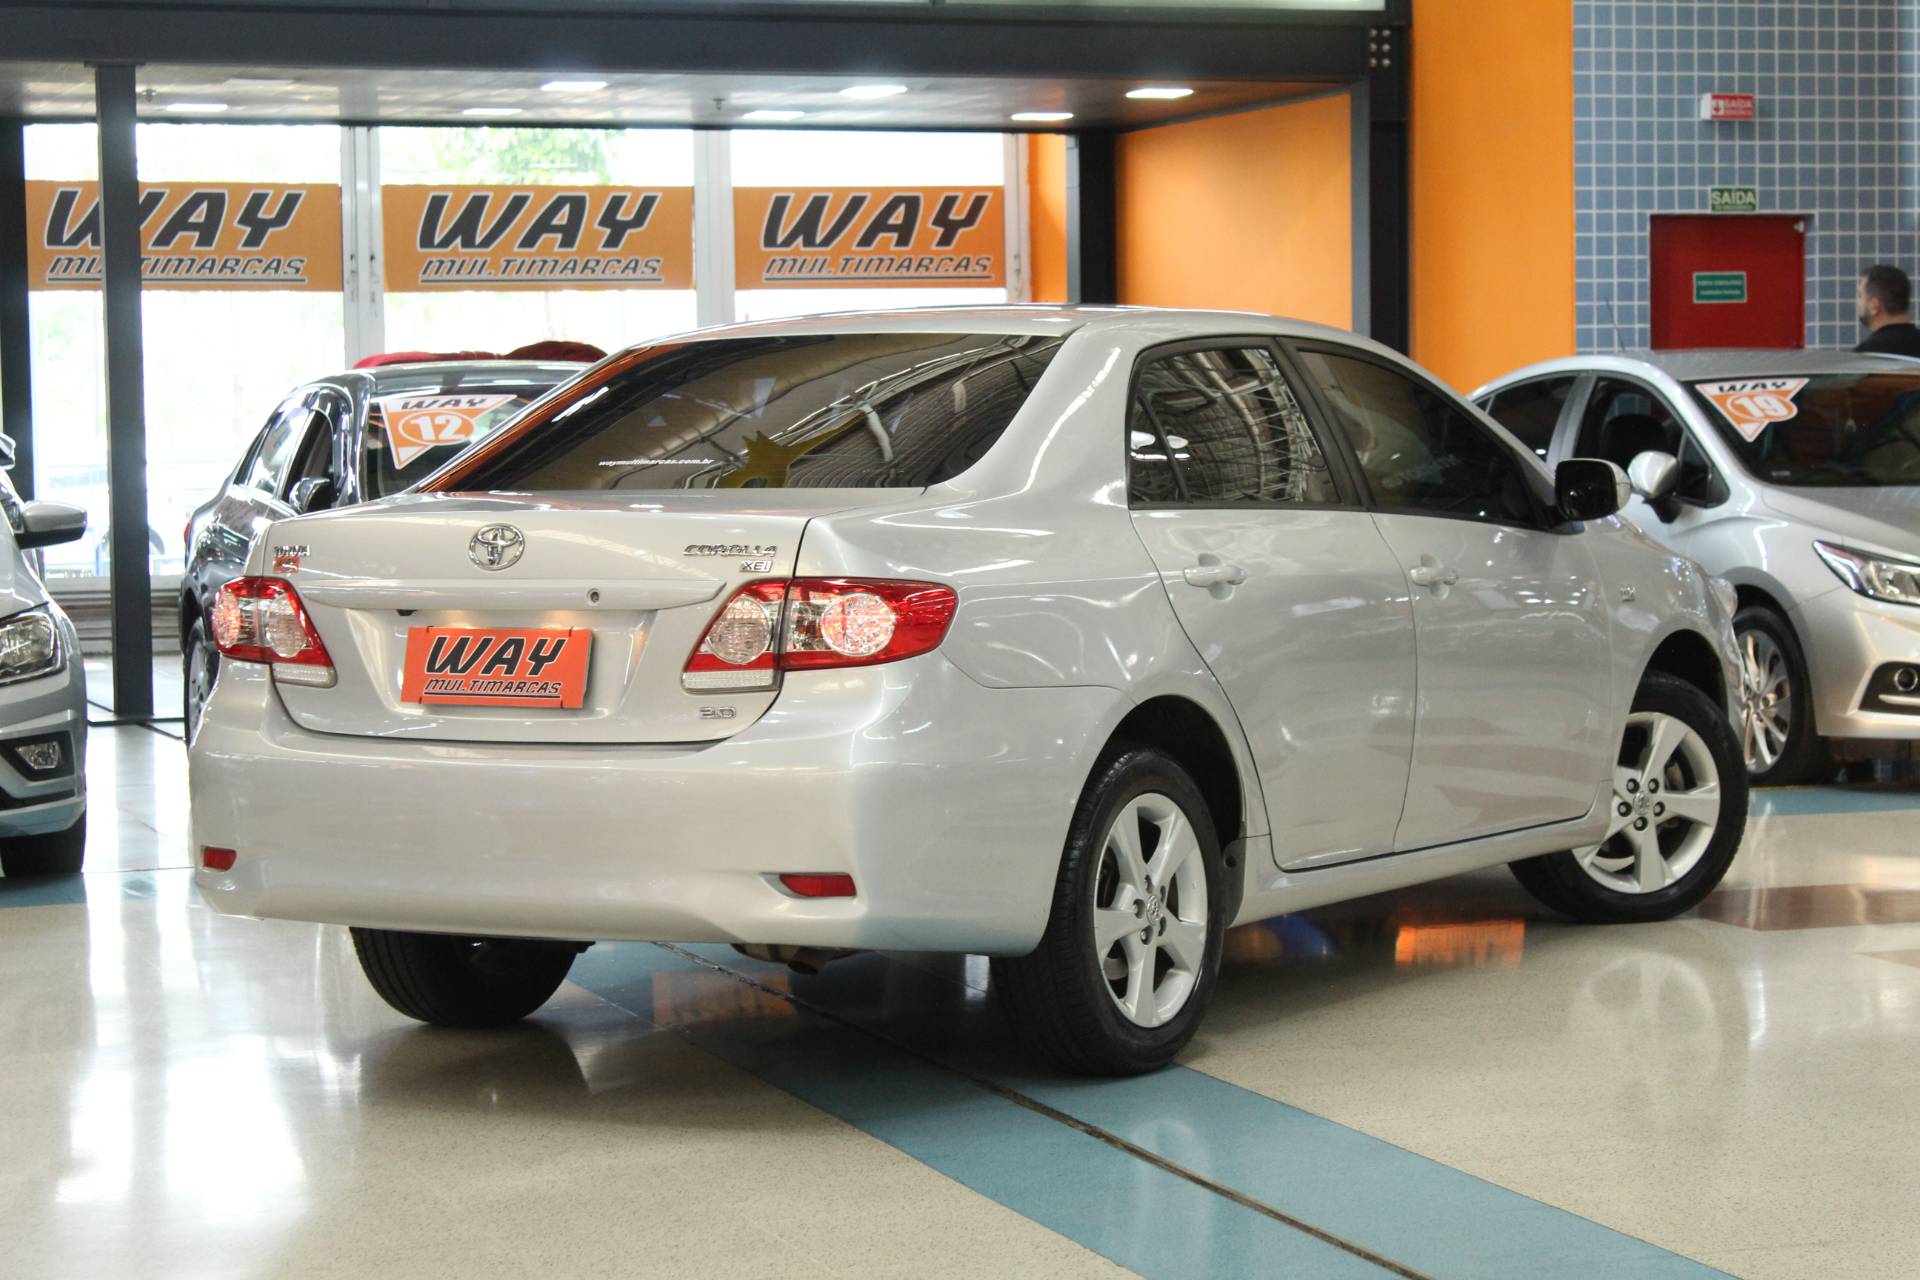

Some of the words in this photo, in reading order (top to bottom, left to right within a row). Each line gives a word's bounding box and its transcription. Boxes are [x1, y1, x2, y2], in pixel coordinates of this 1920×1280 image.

[1711, 188, 1756, 205] SAÍDA
[416, 191, 663, 252] WAY
[761, 191, 993, 251] WAY
[49, 255, 306, 277] MUTIMARCAS
[420, 257, 664, 276] MULTIMARCAS
[765, 255, 993, 275] MULTIMARCAS
[1718, 382, 1786, 393] WAY
[402, 398, 487, 410] WAY
[1732, 394, 1789, 418] 19
[411, 415, 468, 441] 12
[425, 635, 568, 677] WAY
[424, 678, 562, 695] MULTIMARCAS
